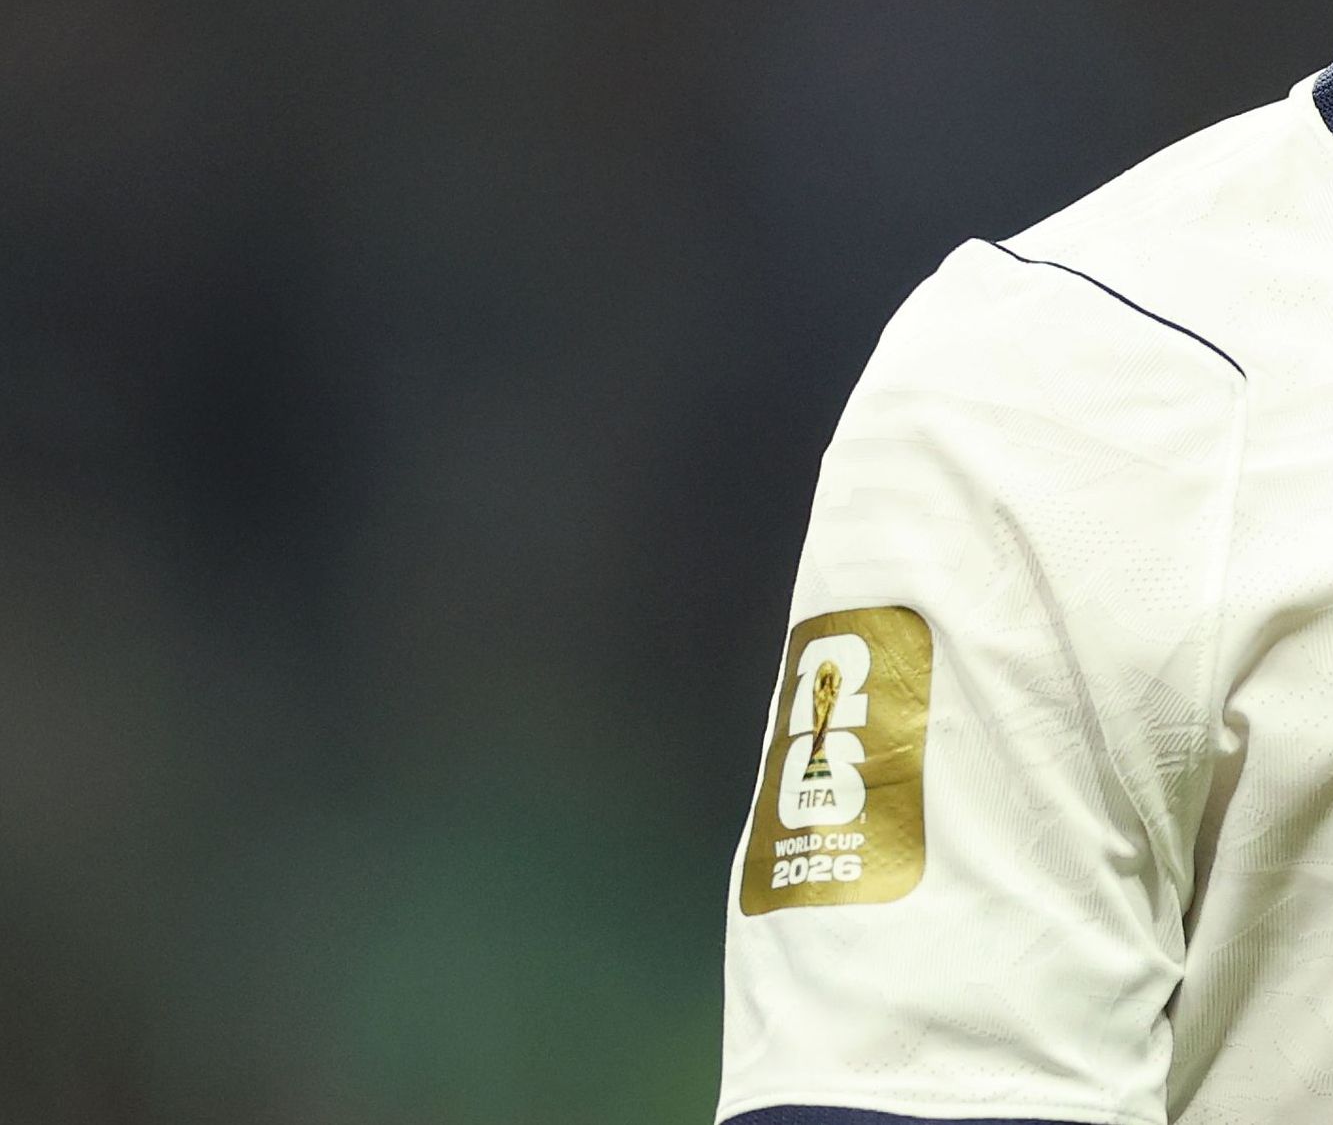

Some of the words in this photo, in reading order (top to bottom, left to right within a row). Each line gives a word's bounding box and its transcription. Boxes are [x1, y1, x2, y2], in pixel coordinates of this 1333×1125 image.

[797, 788, 837, 810] FIFA
[774, 833, 822, 857] WORLD
[824, 832, 865, 851] CUP
[771, 854, 863, 889] 2026
